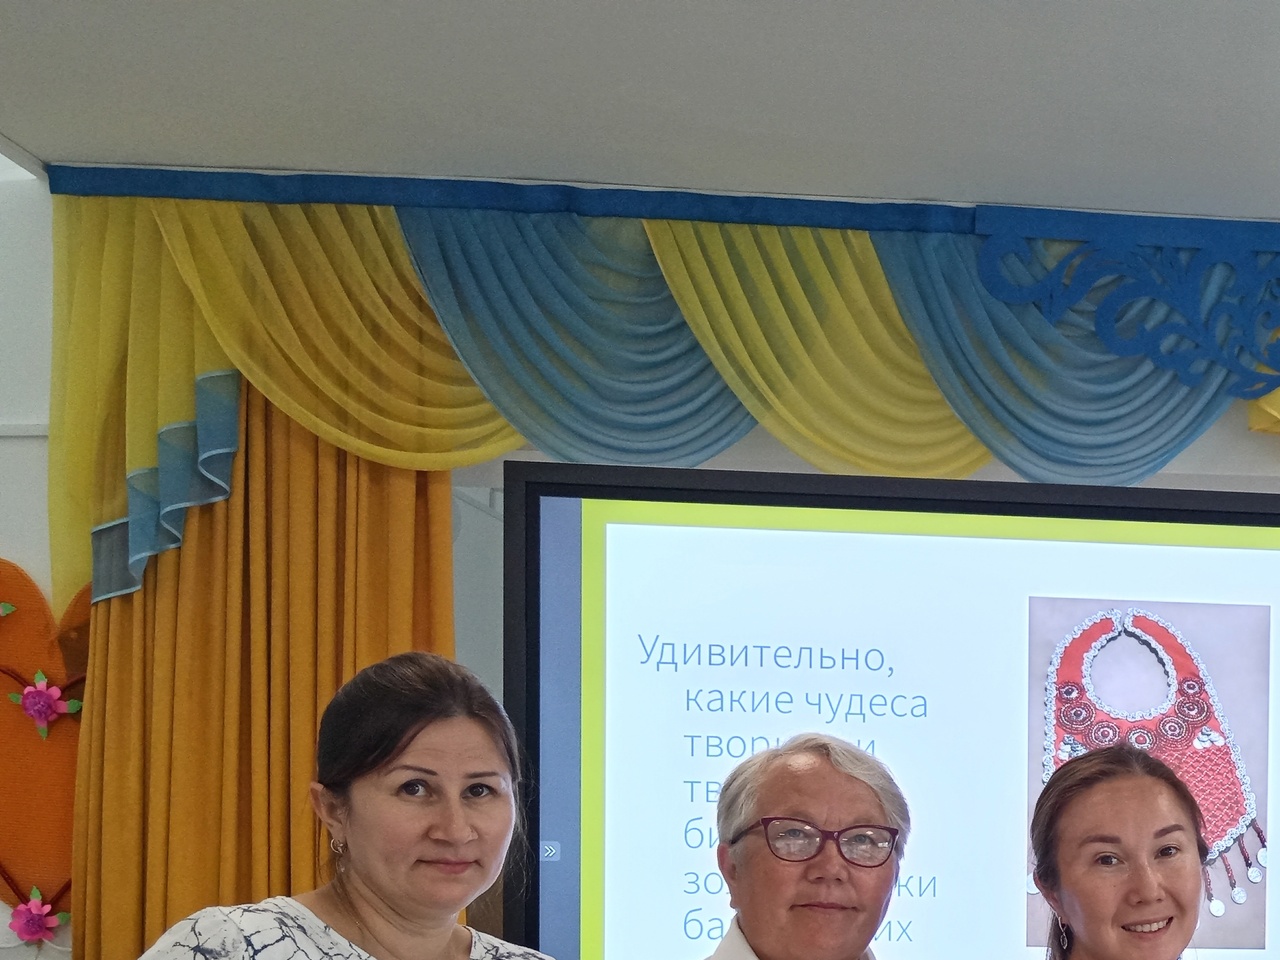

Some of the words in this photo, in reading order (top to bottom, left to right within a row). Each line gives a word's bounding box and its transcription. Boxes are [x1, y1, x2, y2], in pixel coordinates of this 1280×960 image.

[638, 633, 895, 676] Удивительно,
[685, 689, 794, 716] какие
[805, 691, 929, 723] чудеса
[683, 735, 779, 758] твор
[684, 871, 731, 895] зо
